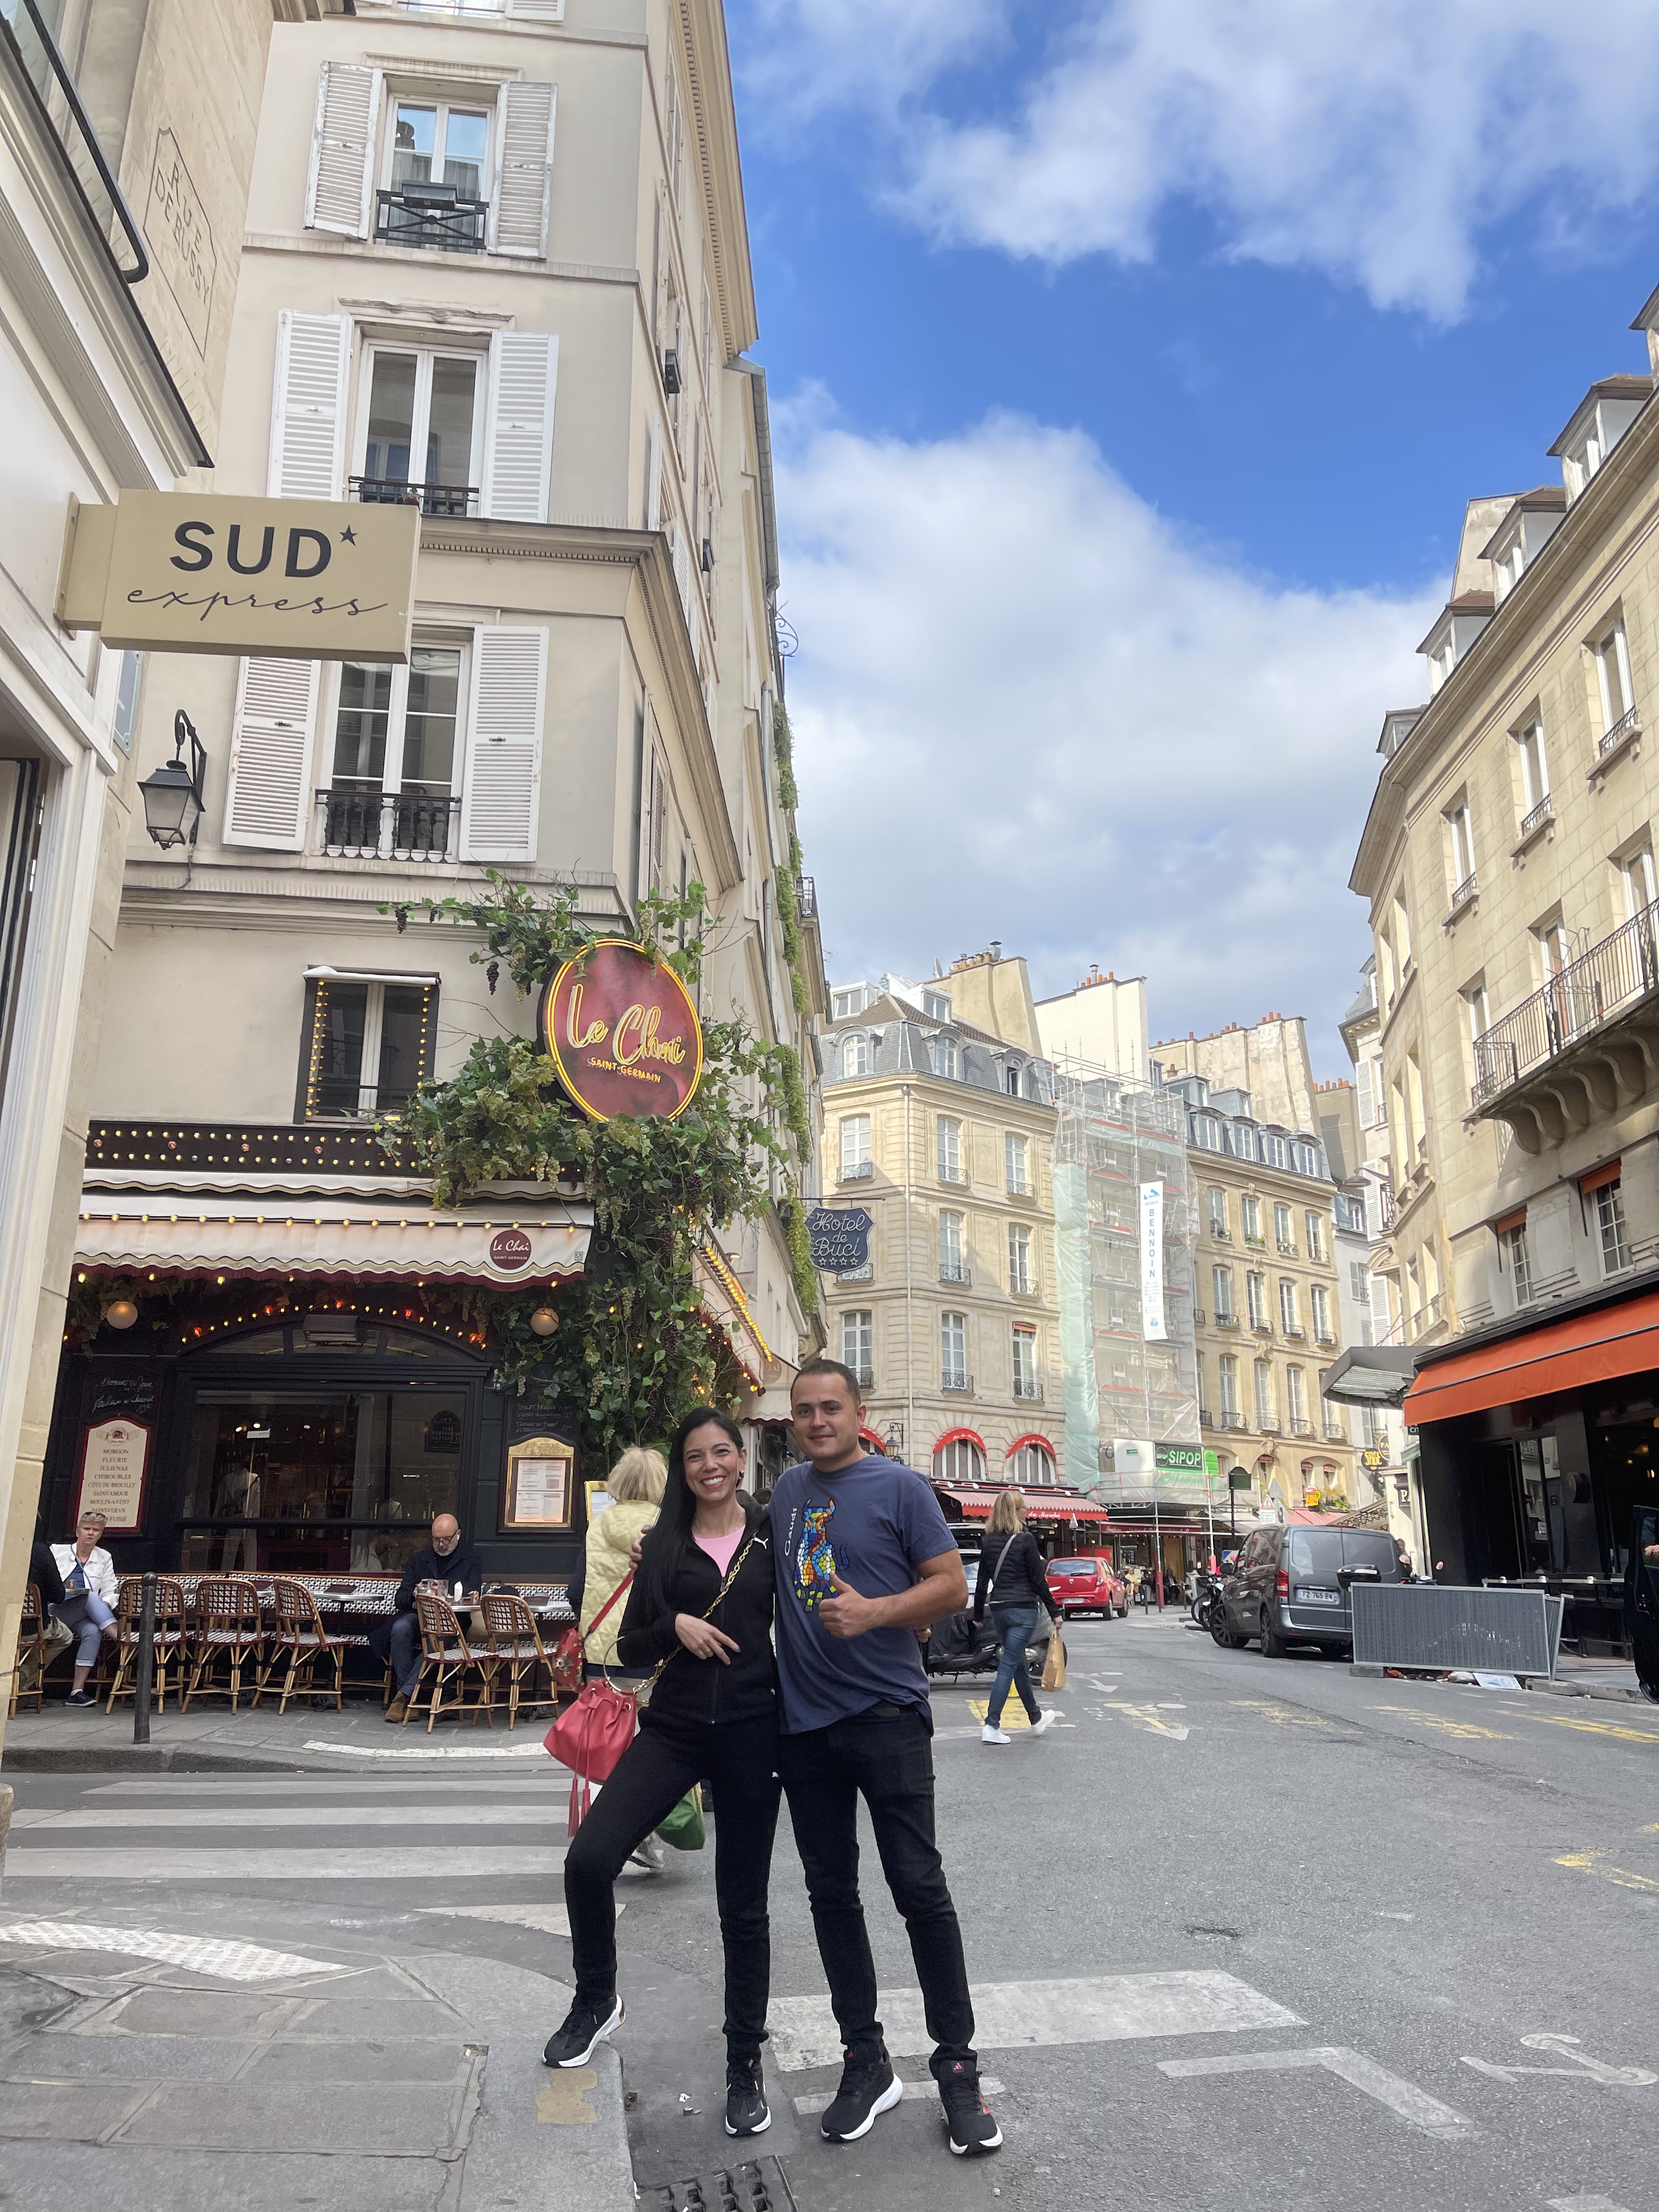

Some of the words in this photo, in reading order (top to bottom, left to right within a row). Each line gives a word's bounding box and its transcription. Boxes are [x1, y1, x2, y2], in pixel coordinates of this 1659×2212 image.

[169, 520, 332, 578] SUD
[126, 589, 388, 622] express
[567, 983, 609, 1049] Le
[612, 1003, 686, 1065] Chai
[586, 1057, 662, 1084] SAINT-GERMAIN
[812, 1212, 865, 1231] Hotel
[493, 1239, 503, 1251] Le
[505, 1239, 530, 1252] Chai
[831, 1231, 848, 1243] de
[1169, 1449, 1201, 1466] SIPOP
